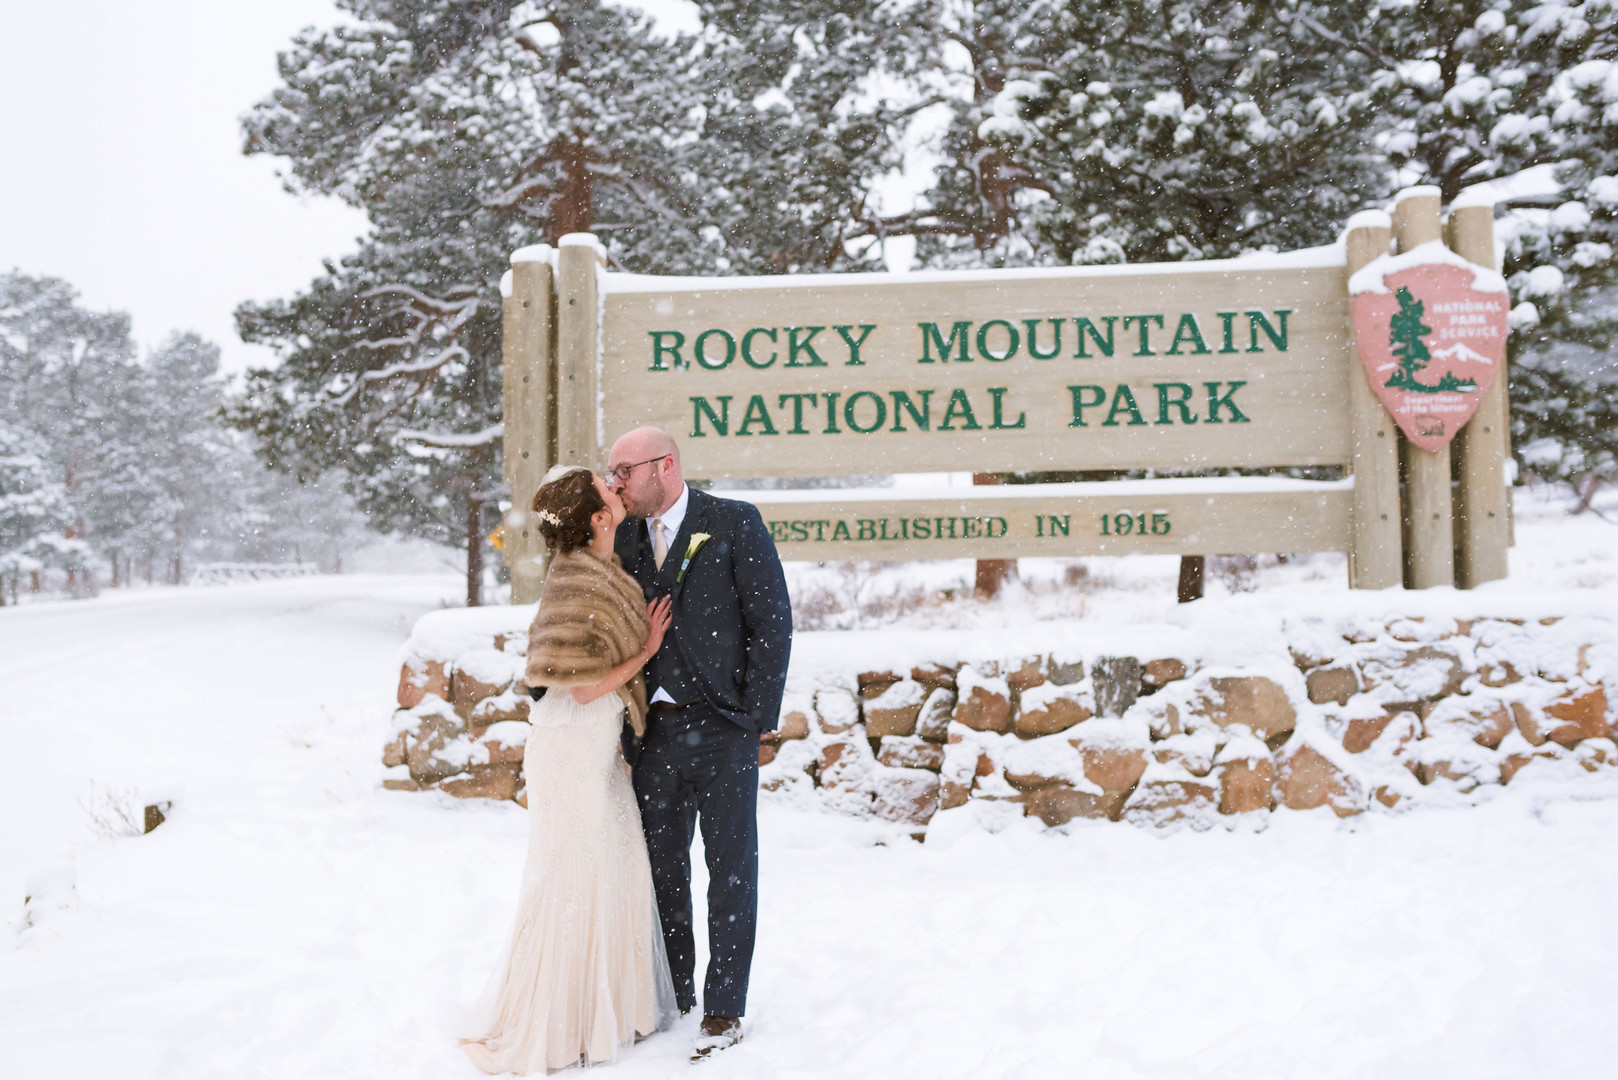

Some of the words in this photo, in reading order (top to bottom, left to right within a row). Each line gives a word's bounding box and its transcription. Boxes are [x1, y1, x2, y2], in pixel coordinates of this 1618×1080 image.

[1433, 301, 1502, 313] NATIONAL
[1450, 314, 1486, 325] PARK
[648, 324, 876, 371] ROCKY
[918, 310, 1291, 363] MOUNTAIN
[1441, 325, 1499, 339] SERVICE
[690, 388, 1025, 437] NATIONAL
[1068, 381, 1250, 426] PARK
[768, 516, 1008, 543] ESTABLISHED
[1037, 516, 1069, 536] IN
[1102, 514, 1170, 535] 1915
